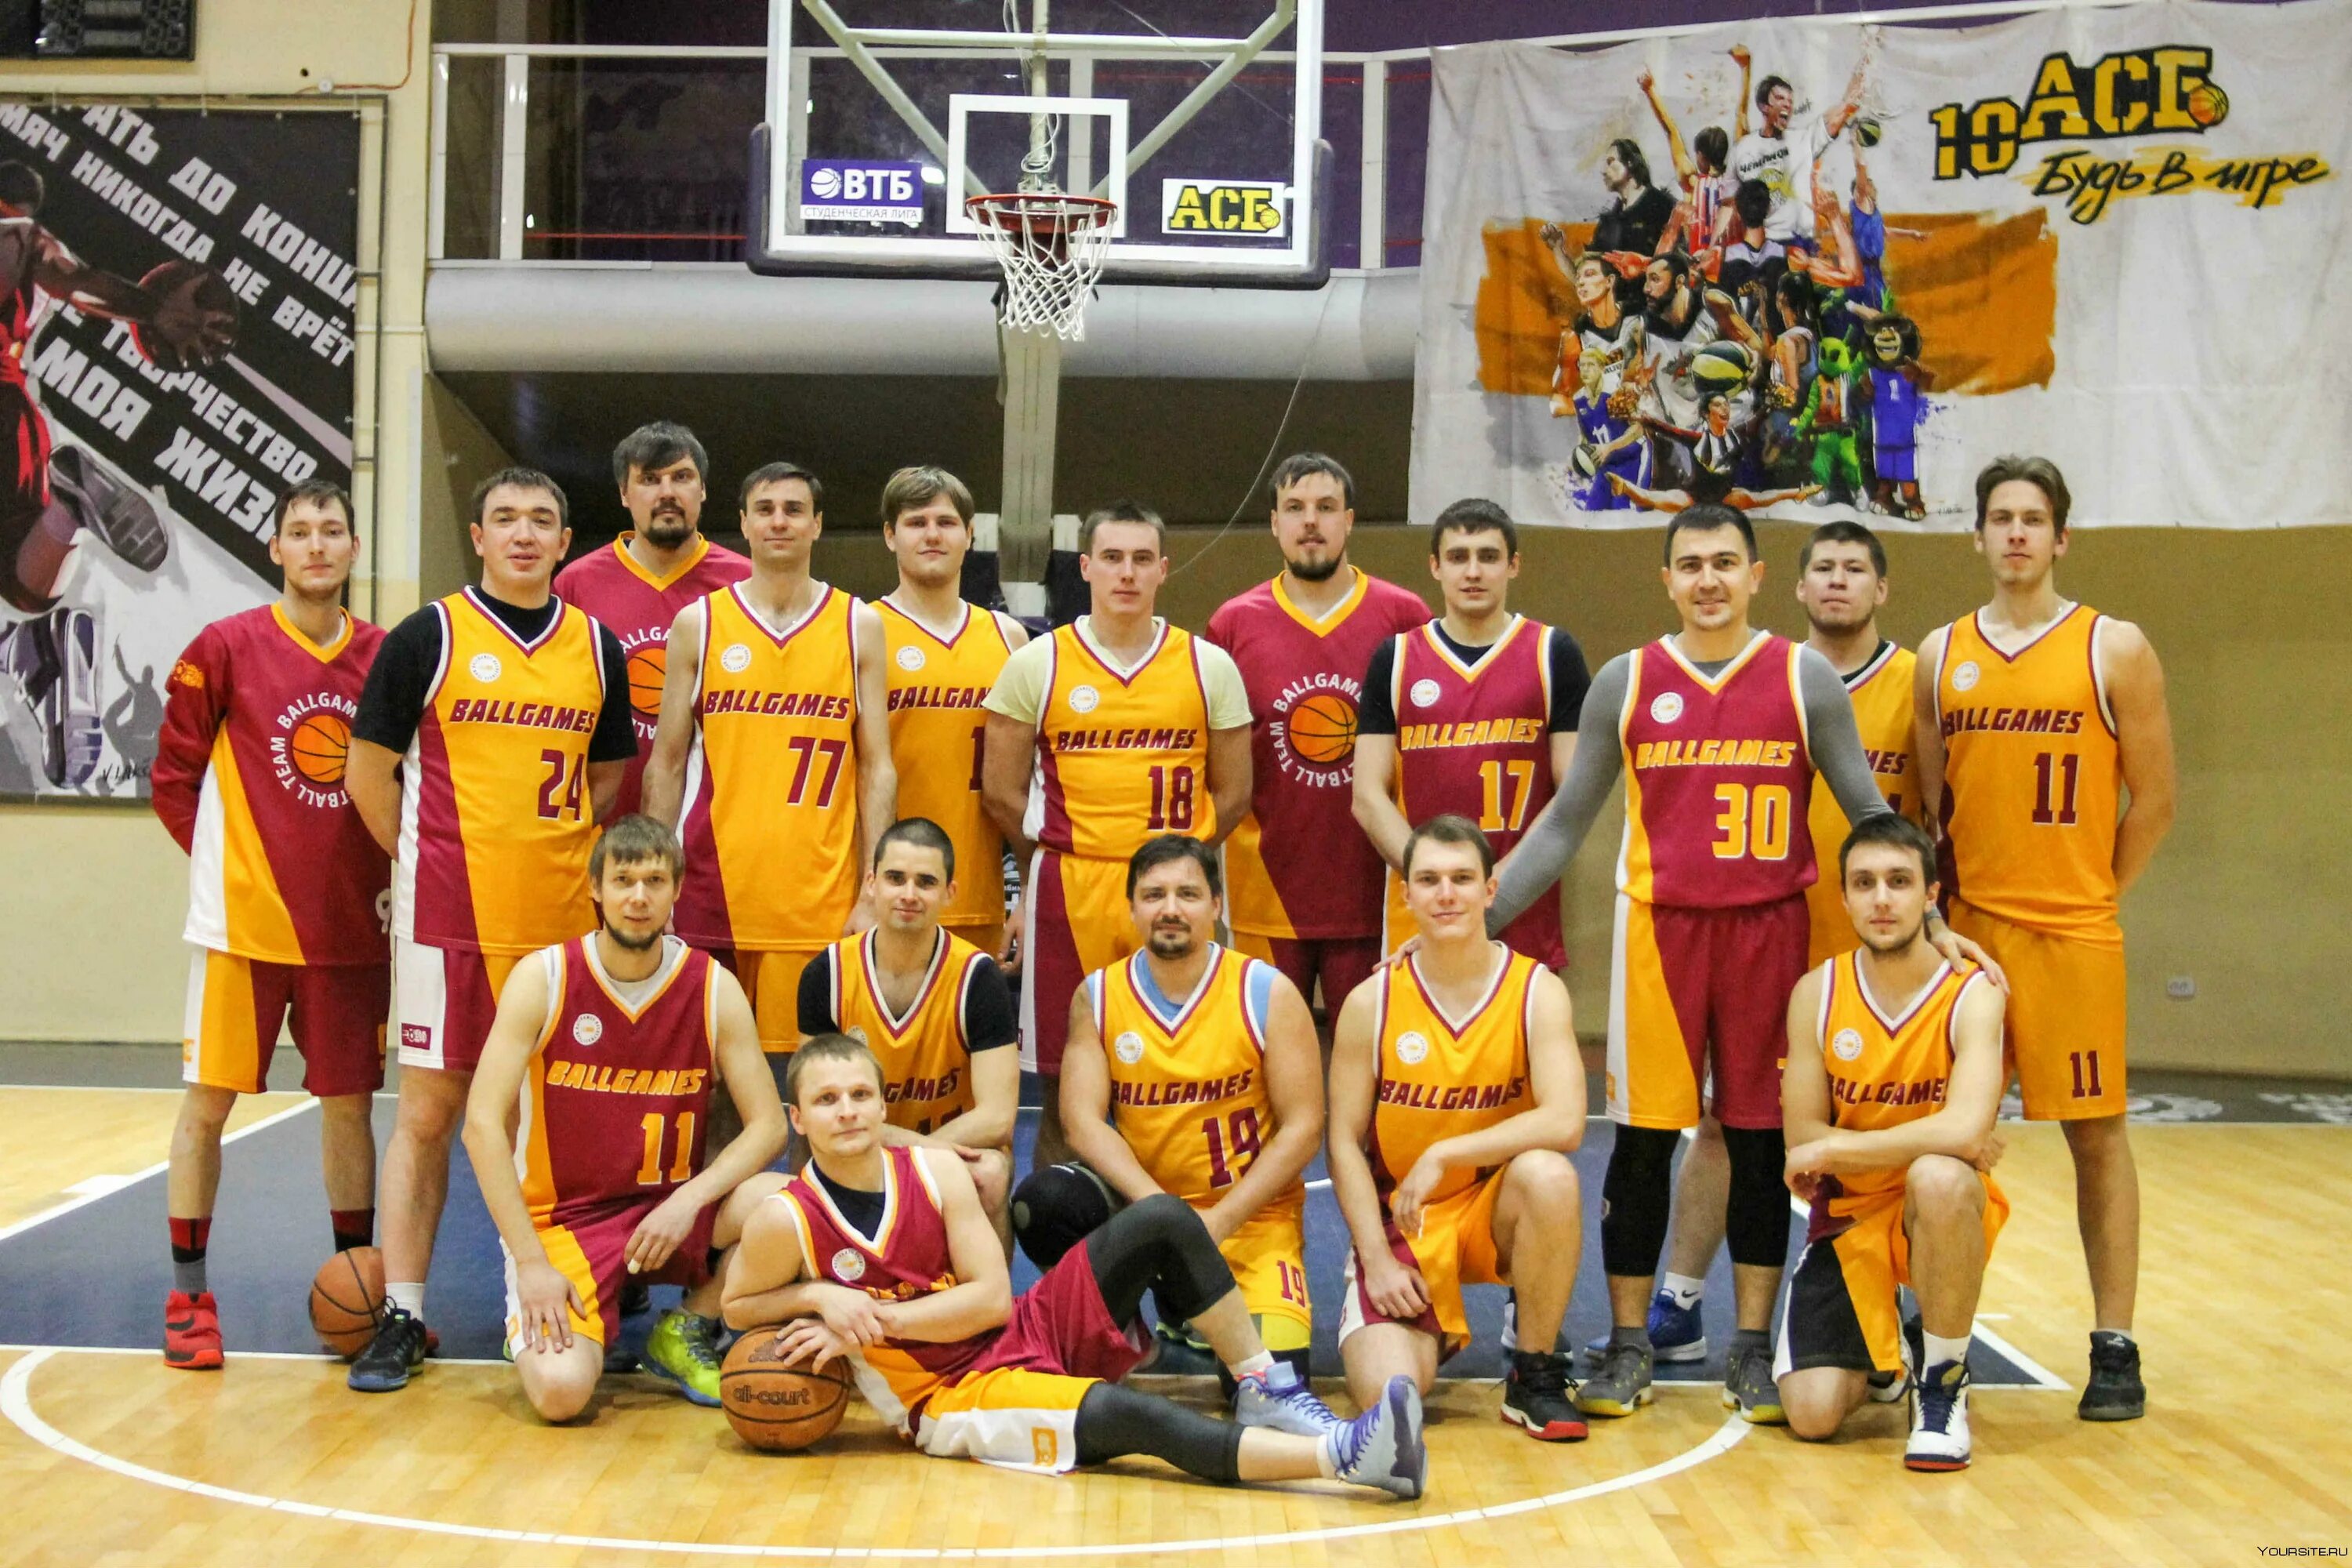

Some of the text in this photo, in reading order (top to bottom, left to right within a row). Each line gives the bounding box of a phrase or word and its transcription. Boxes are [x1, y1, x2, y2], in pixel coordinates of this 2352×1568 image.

[78, 104, 160, 166] АТЬ
[167, 157, 238, 216] ДО
[844, 169, 913, 201] ВТБ
[0, 104, 355, 368] МЯЧ НИКОГДА НЕ ВРЁТ
[804, 206, 918, 220] СТУДЕНЧЕСКАЯ ЛИГА
[32, 336, 153, 441] МОЯ
[449, 699, 595, 734] BALLGAMES
[704, 689, 851, 720] BALLGAMES
[885, 686, 993, 713] BALLGAM
[270, 691, 358, 808] BALLGAM TBALL TEAM
[1055, 728, 1198, 752] BALLGAMES
[1269, 672, 1363, 789] BALLGAM TBALL TEAM
[1400, 718, 1543, 751] BALLGAMES
[1635, 739, 1797, 769] BALLGAMES
[538, 749, 586, 822] 24
[786, 735, 848, 809] 77
[1479, 760, 1536, 832] 17
[2032, 752, 2081, 826] 11
[1147, 765, 1196, 831] 18
[1711, 782, 1791, 861] 30
[546, 1060, 708, 1096] BALLGAMES
[883, 1067, 962, 1105] GAMES
[1826, 1073, 1948, 1106] ALLGAME
[2069, 1050, 2103, 1098] 11
[636, 1111, 695, 1185] 11
[1201, 1105, 1262, 1190] 19
[1276, 1258, 1307, 1309] 19
[732, 1385, 810, 1406] all-court
